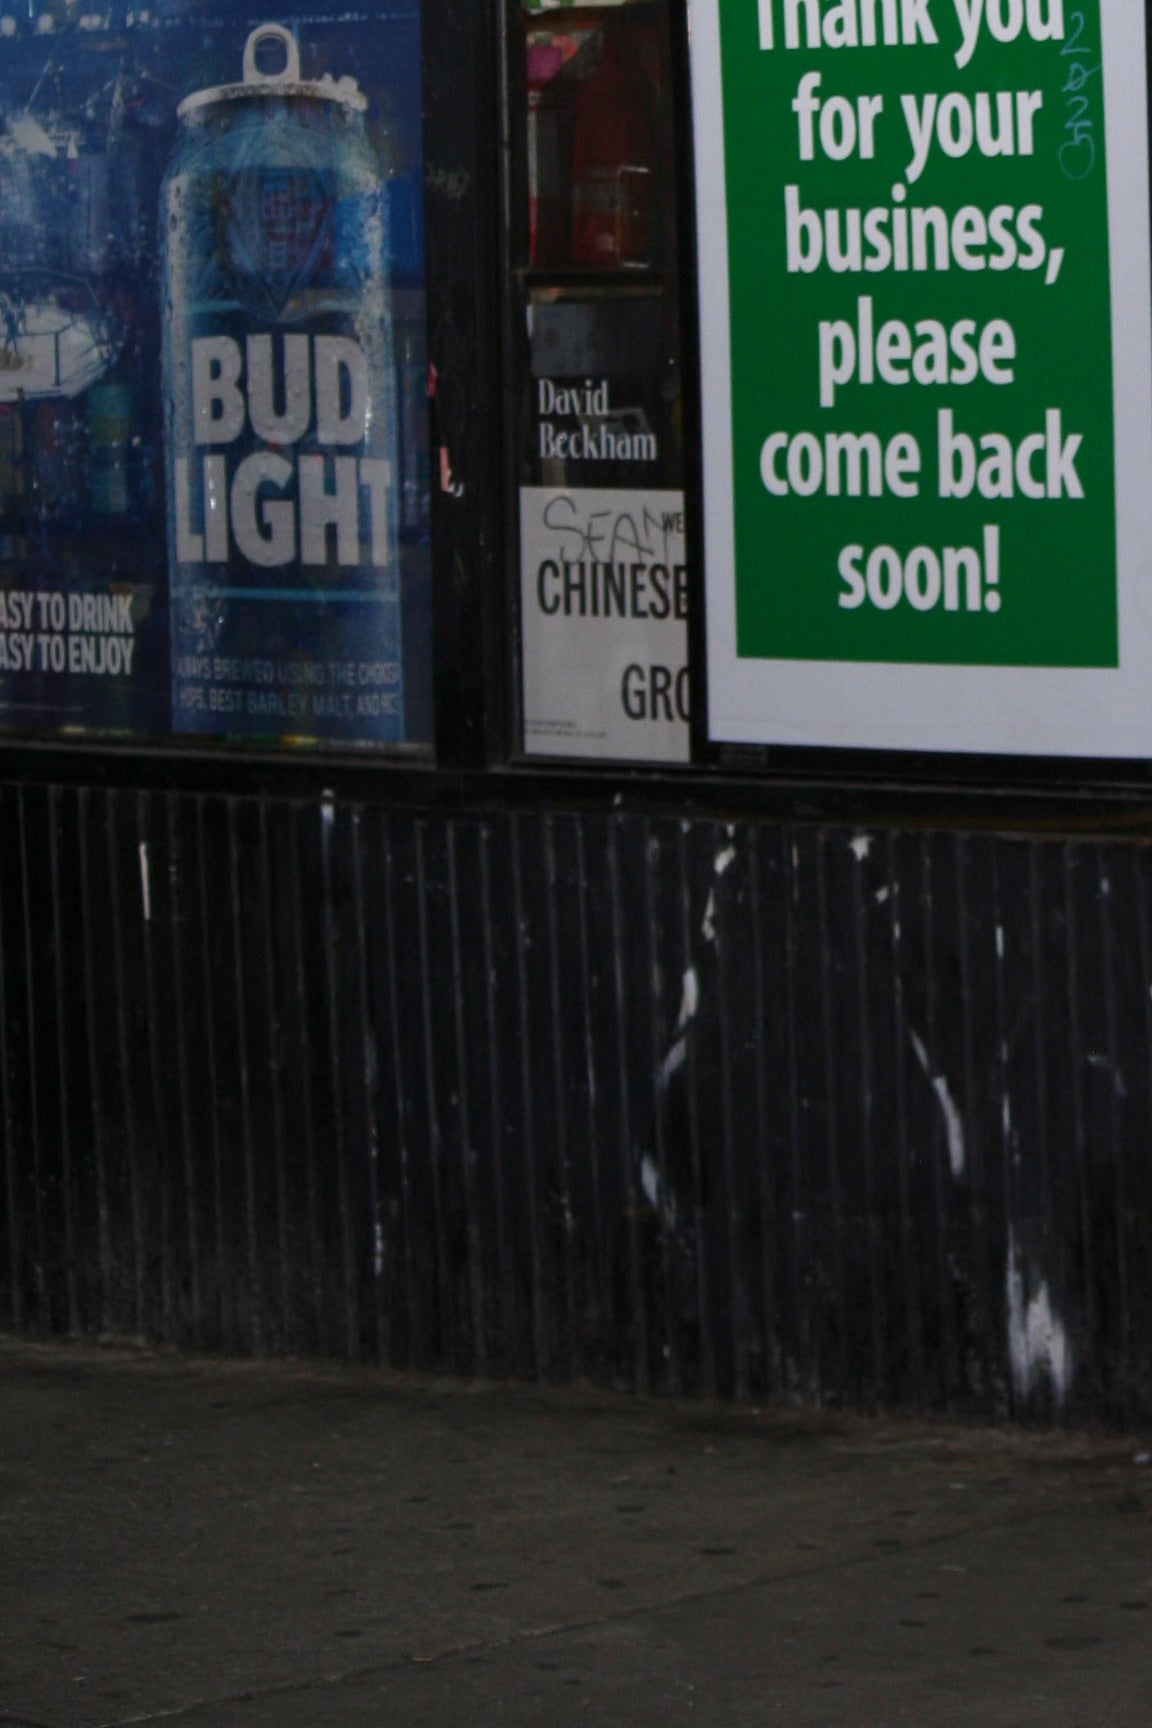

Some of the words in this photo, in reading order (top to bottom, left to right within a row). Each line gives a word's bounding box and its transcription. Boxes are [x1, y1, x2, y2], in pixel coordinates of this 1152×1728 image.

[791, 70, 883, 161] for
[900, 89, 1043, 184] your
[784, 183, 1065, 286] business,
[191, 333, 369, 447] BUD
[818, 295, 1016, 408] please
[538, 379, 610, 417] David
[538, 422, 657, 462] Beckham
[759, 431, 921, 497] come
[938, 408, 1085, 500] back
[176, 452, 393, 569] LIGHT
[37, 591, 67, 632] TO
[68, 592, 135, 634] DRINK
[537, 559, 689, 621] CHINESE
[837, 524, 1002, 613] soon!
[37, 633, 67, 674] TO
[68, 635, 135, 677] ENJOY
